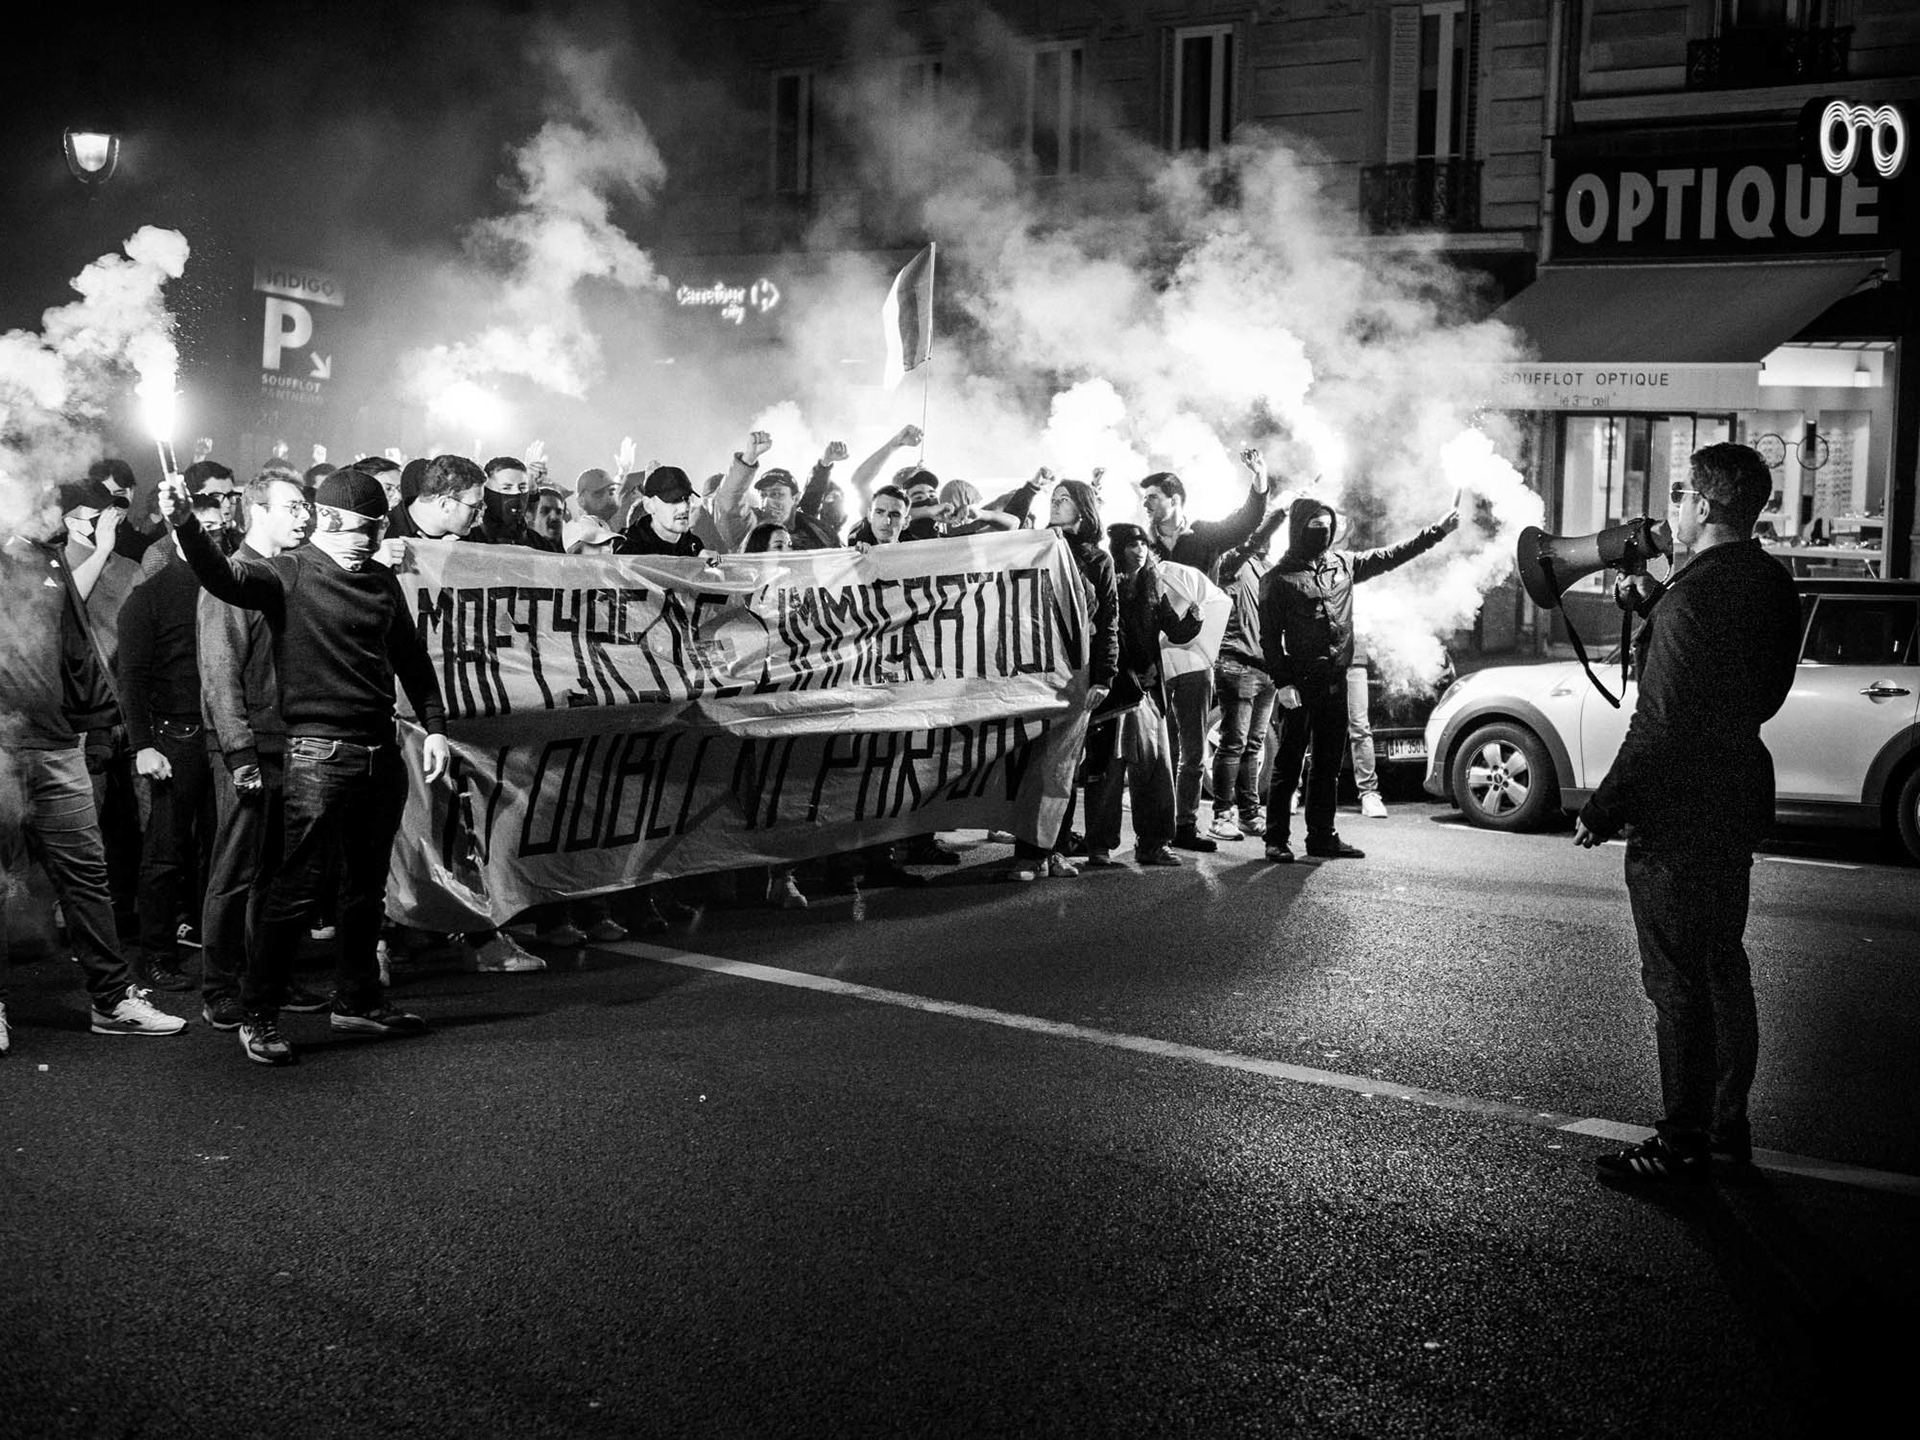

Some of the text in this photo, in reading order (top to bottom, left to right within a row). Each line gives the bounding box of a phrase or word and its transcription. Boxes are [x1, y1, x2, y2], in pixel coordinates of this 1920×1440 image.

[1565, 164, 1879, 244] OPTIQUE
[266, 270, 335, 297] INDIGO
[262, 296, 313, 370] P
[1500, 372, 1669, 386] SOUFFLOT OPTIQUE
[517, 730, 722, 858] OUBLI
[731, 736, 798, 830] NI
